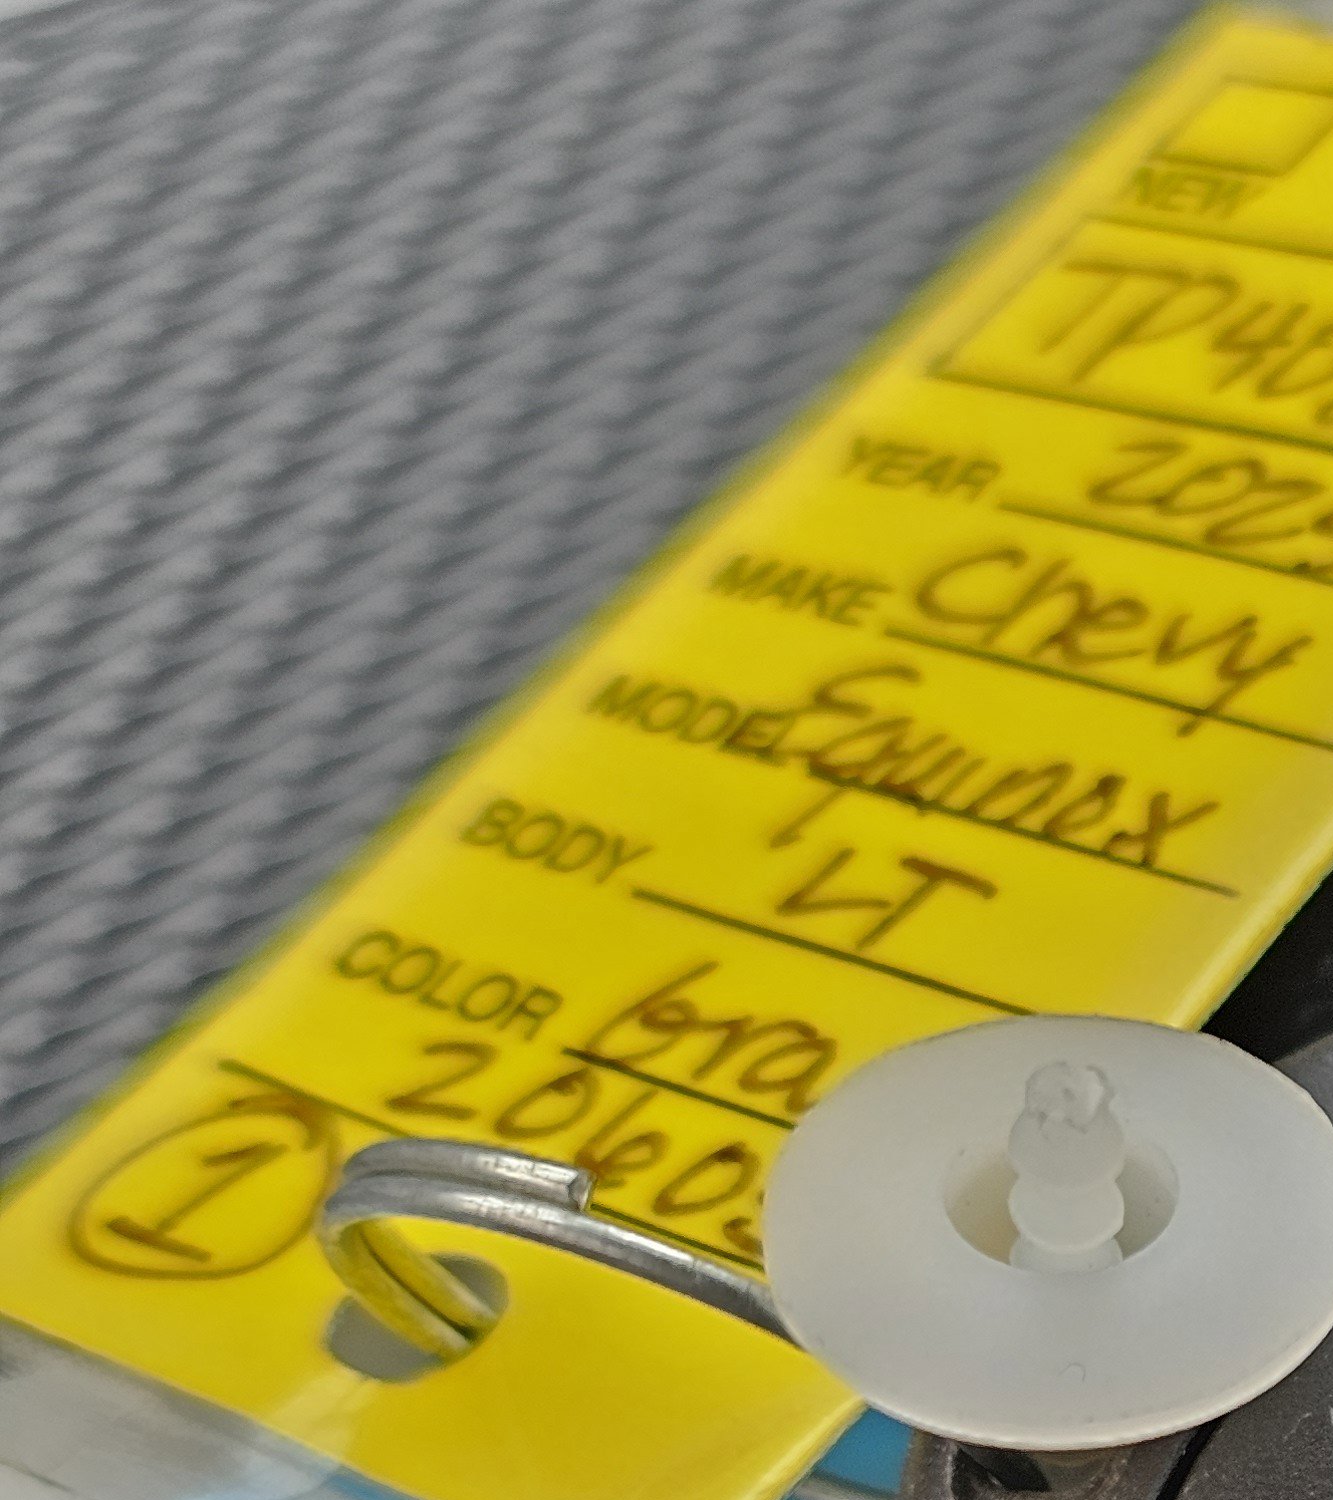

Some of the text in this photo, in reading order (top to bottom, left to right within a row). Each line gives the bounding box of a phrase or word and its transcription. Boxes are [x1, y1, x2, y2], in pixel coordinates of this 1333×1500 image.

[1130, 165, 1262, 220] NEW
[843, 434, 1000, 504] YEAR
[706, 552, 892, 628] MAKE
[913, 545, 1315, 739] Chevy
[585, 673, 797, 768] MODEL
[458, 798, 652, 884] BODY
[771, 844, 998, 949] LT
[333, 928, 564, 1042] COLOR
